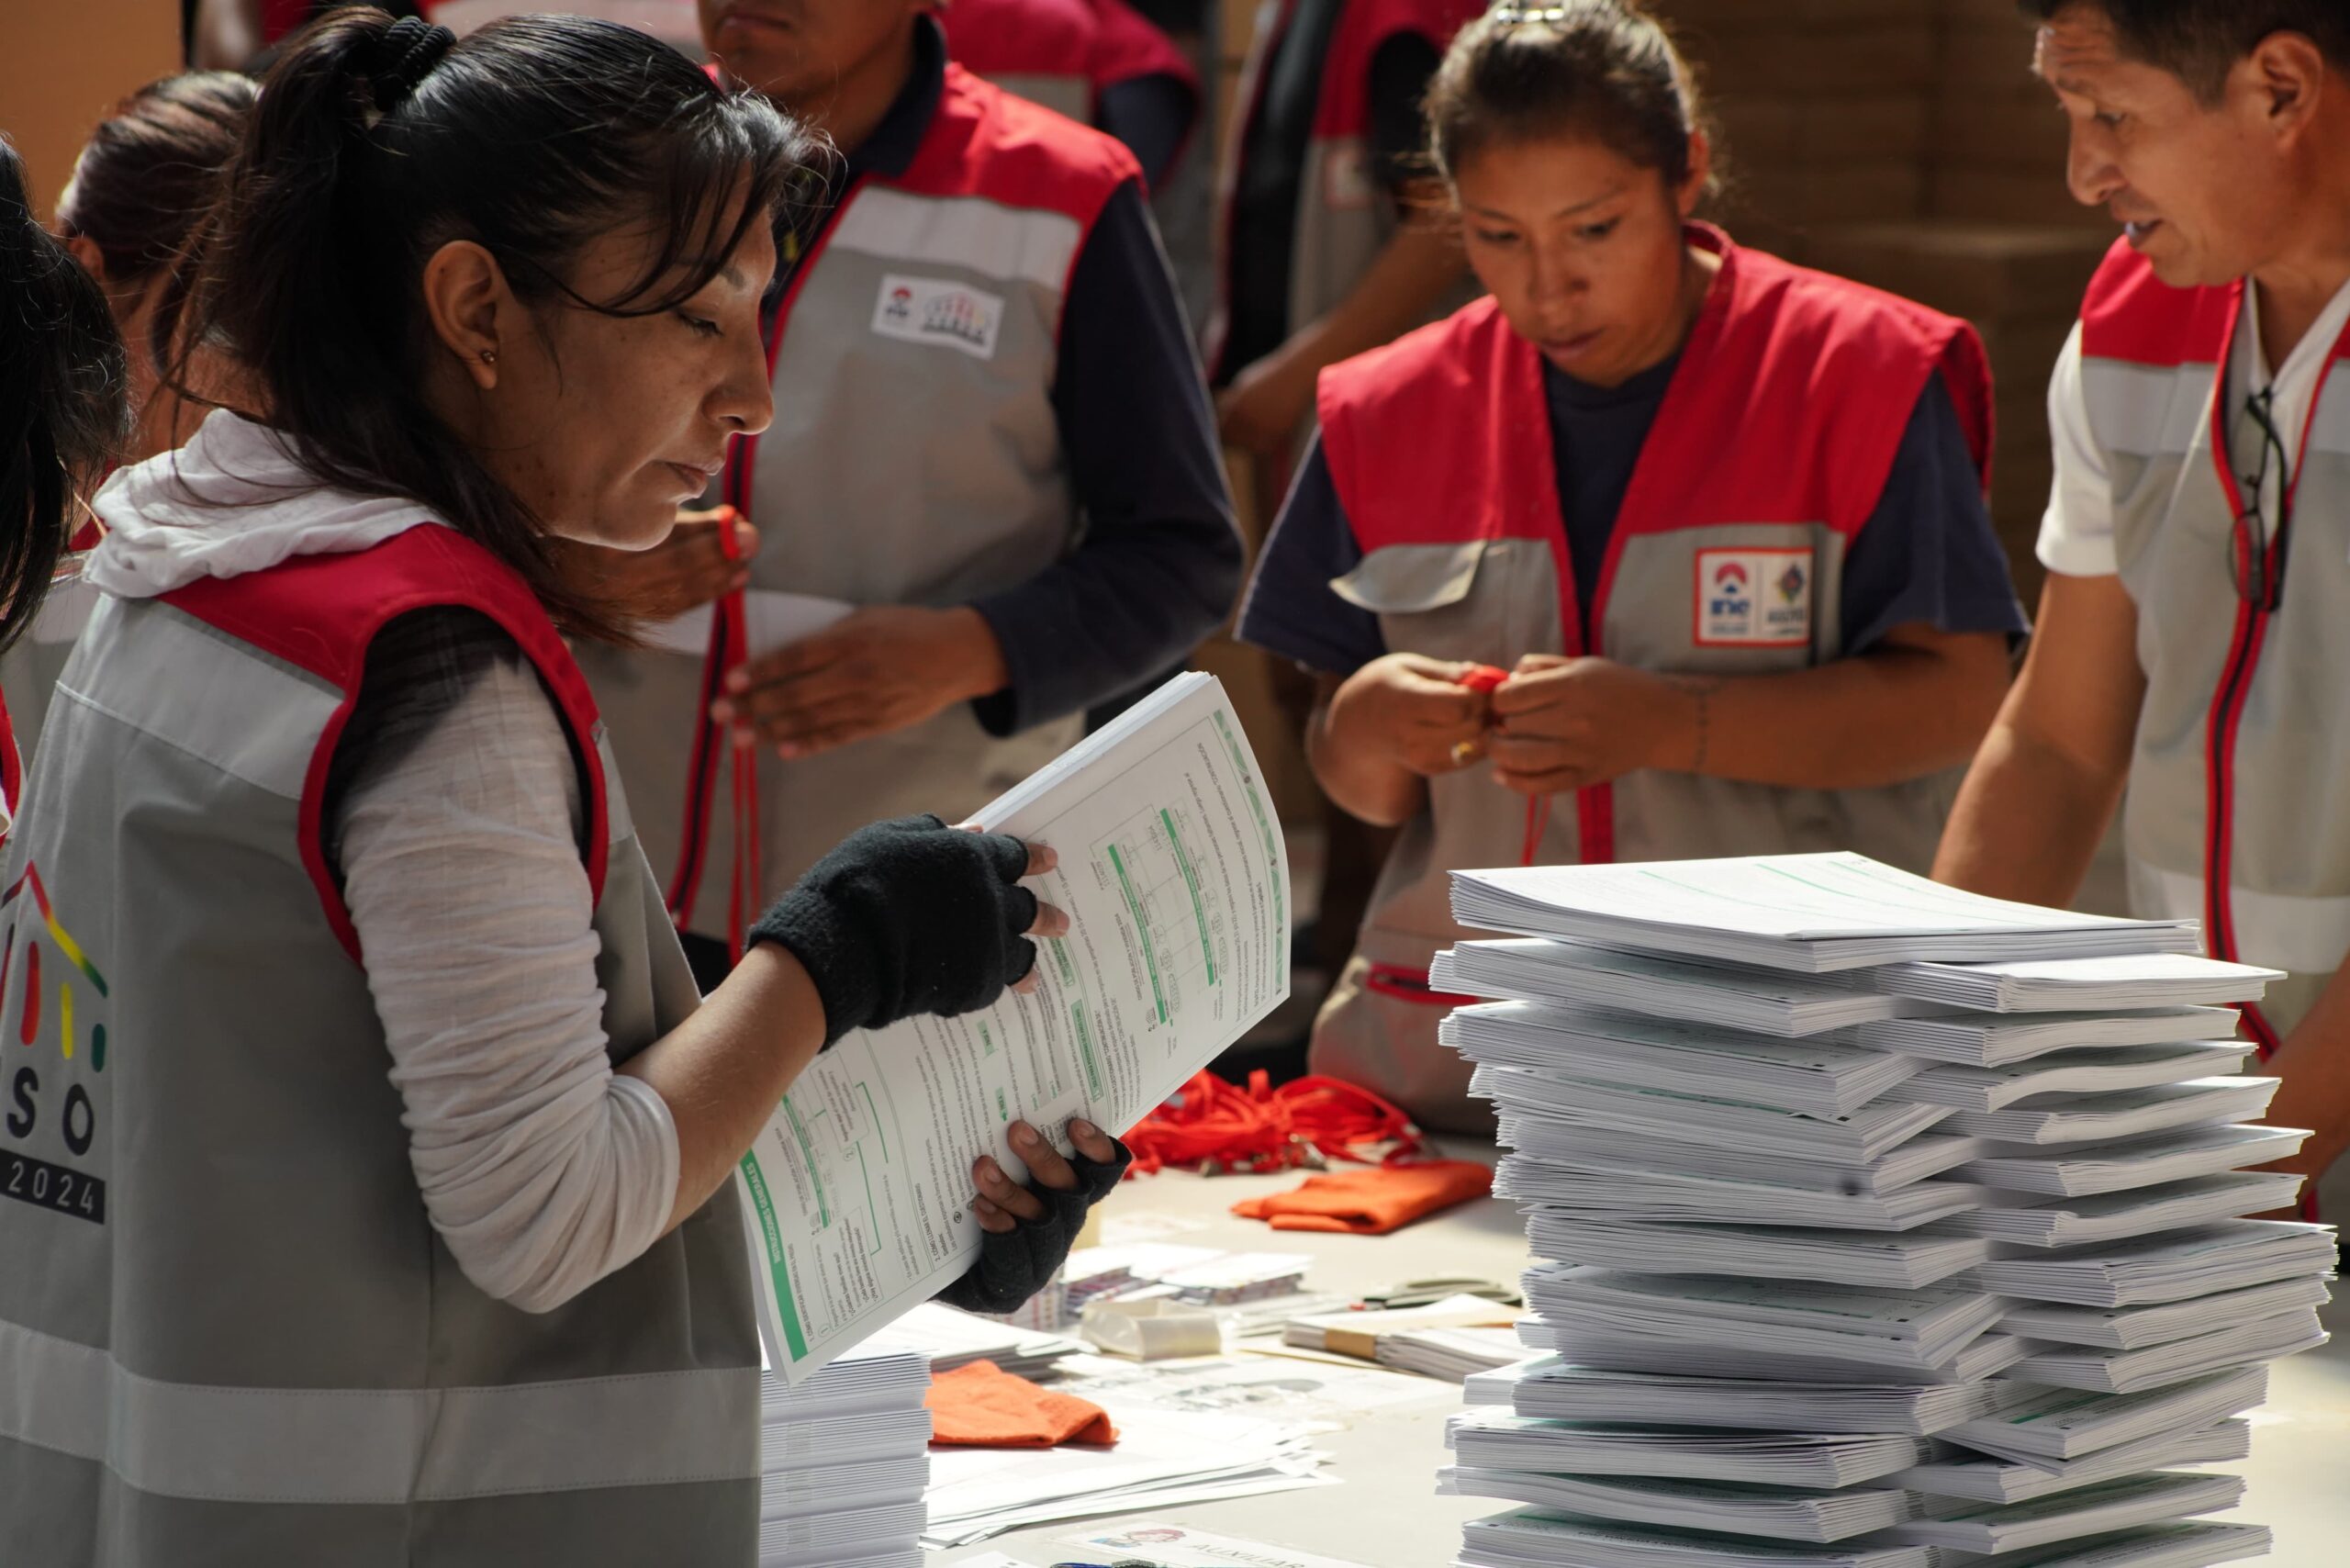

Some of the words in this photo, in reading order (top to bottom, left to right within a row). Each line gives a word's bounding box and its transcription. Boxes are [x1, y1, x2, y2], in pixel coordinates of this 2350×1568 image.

[8, 1160, 95, 1214] 2024
[745, 1161, 768, 1208] GENERALES
[914, 1182, 927, 1215] CUESTIONARIO
[761, 1207, 782, 1263] INSTRUCCIONES
[923, 1221, 934, 1239] LLENAR
[928, 1238, 939, 1255] CÓMO
[797, 1293, 809, 1321] IDENTIFICAR
